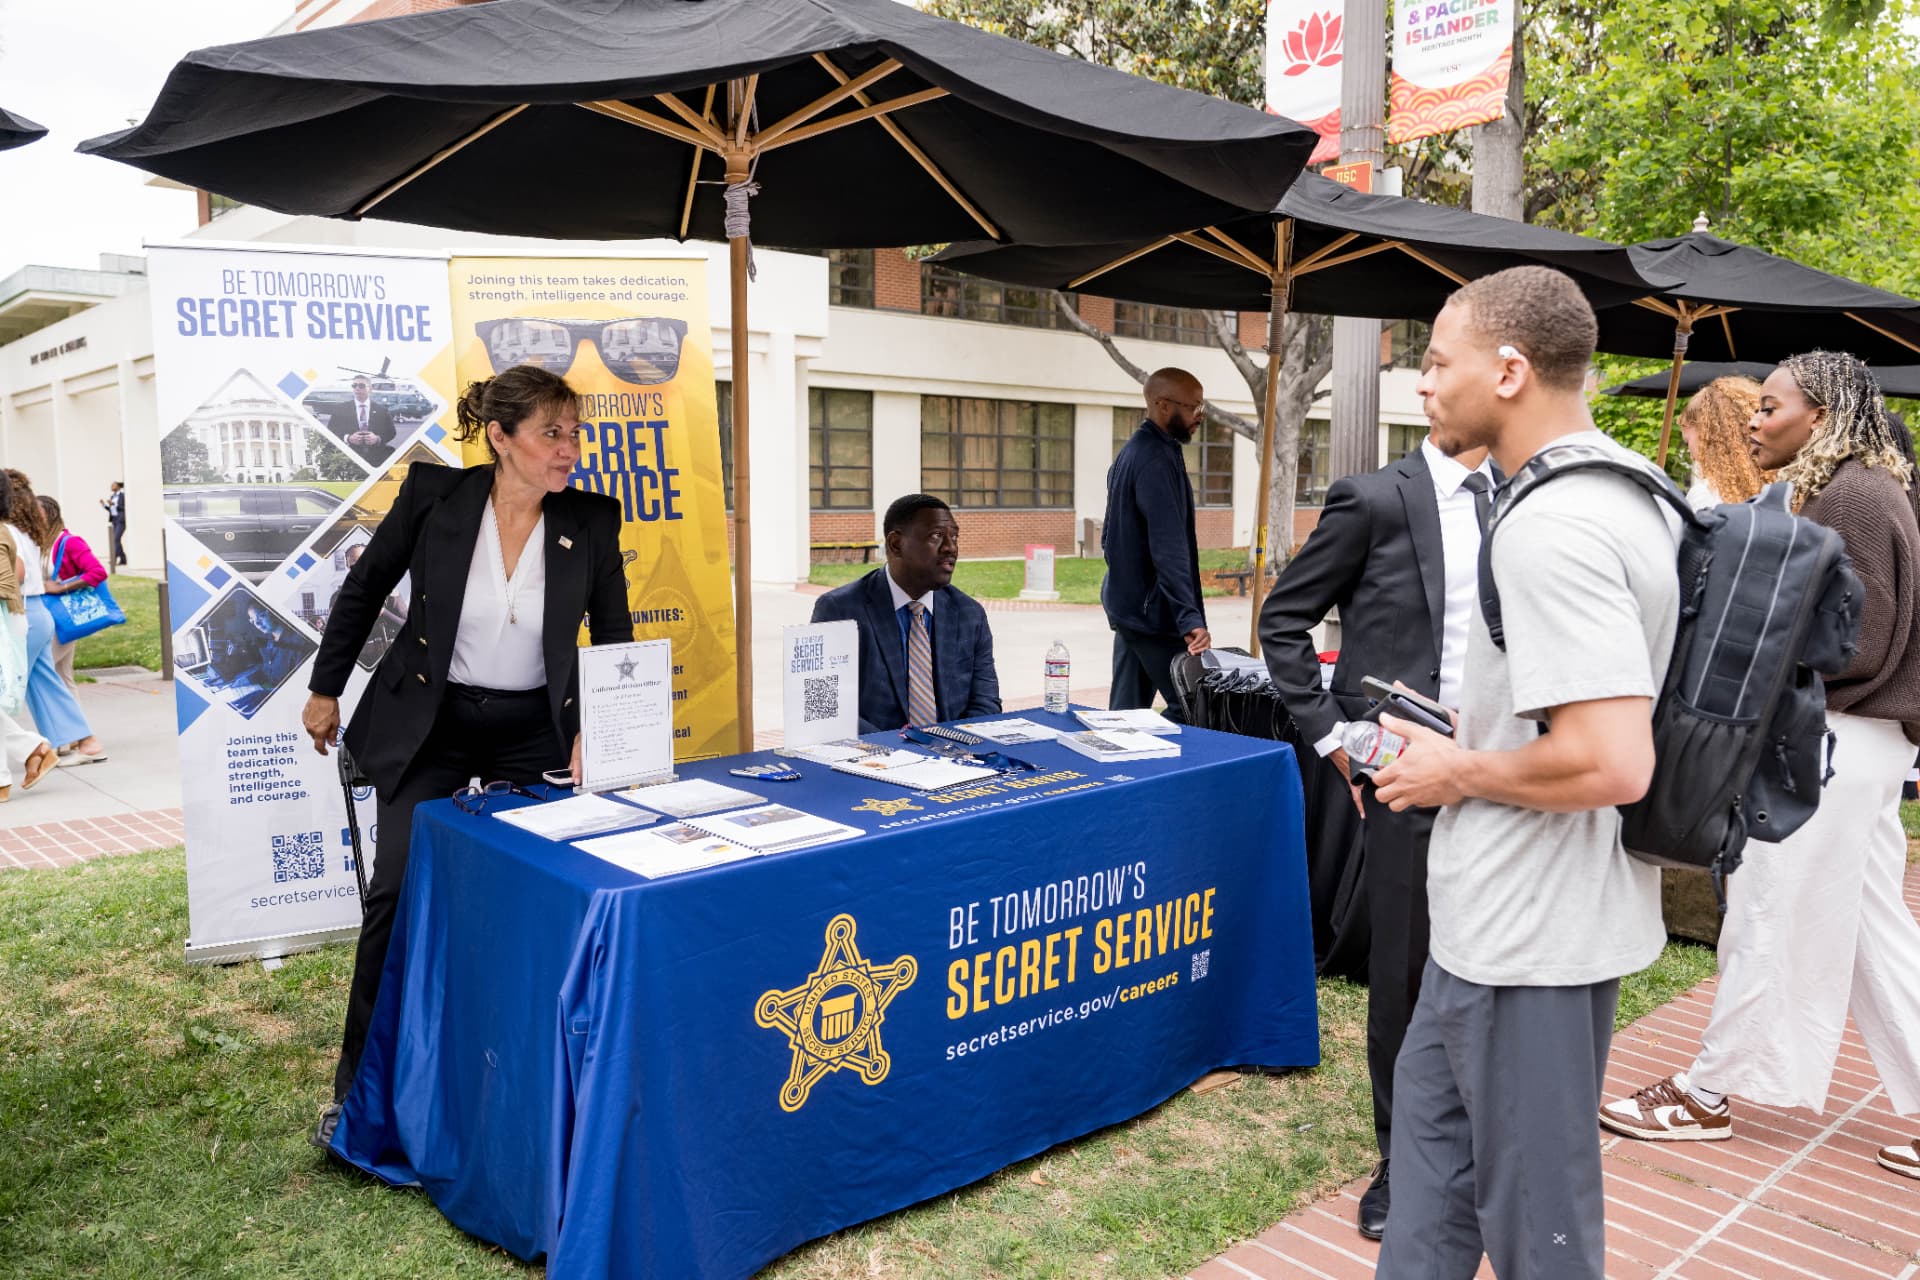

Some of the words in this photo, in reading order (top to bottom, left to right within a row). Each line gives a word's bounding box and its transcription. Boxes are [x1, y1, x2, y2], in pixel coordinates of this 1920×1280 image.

[1408, 10, 1420, 26] &
[1425, 0, 1497, 21] PACIF
[1406, 9, 1499, 45] ISLANDER
[1421, 39, 1456, 52] HERITAGE
[1456, 33, 1482, 44] MONTH
[222, 269, 248, 295] BE
[251, 270, 386, 300] TOMORROW'S
[467, 274, 515, 287] Joining
[519, 274, 543, 286] this
[547, 276, 579, 286] team
[583, 275, 616, 286] takes
[620, 275, 689, 288] dedication,
[469, 290, 528, 302] strength,
[532, 290, 606, 302] intelligence
[609, 290, 633, 301] and
[636, 292, 689, 302] courage.
[176, 297, 297, 338] SECRET
[306, 300, 432, 342] SERVICE
[580, 392, 664, 417] ORROW'S
[574, 420, 669, 474] CRET
[568, 468, 684, 522] VICE
[794, 643, 824, 659] SECRET
[791, 657, 824, 673] SERVICE
[226, 734, 272, 746] Joining
[276, 732, 298, 743] this
[227, 747, 258, 758] team
[262, 745, 295, 755] takes
[228, 757, 298, 769] dedication,
[228, 768, 284, 781] strength,
[229, 779, 302, 793] intelligence
[230, 794, 253, 805] and
[257, 790, 310, 802] courage.
[928, 783, 1008, 805] SECRET
[1003, 769, 1088, 790] SERVICE
[250, 884, 361, 908] secretservice.
[949, 901, 980, 950] BE
[989, 861, 1146, 939] TOMORROW'S
[946, 926, 1083, 1020] SECRET
[1093, 887, 1217, 974] SERVICE
[804, 975, 838, 1015] UNITED
[842, 971, 874, 999] STATES
[946, 970, 1179, 1061] secretservice.gov/careers
[803, 1027, 833, 1057] SECRET
[838, 1011, 874, 1055] SERVICE
